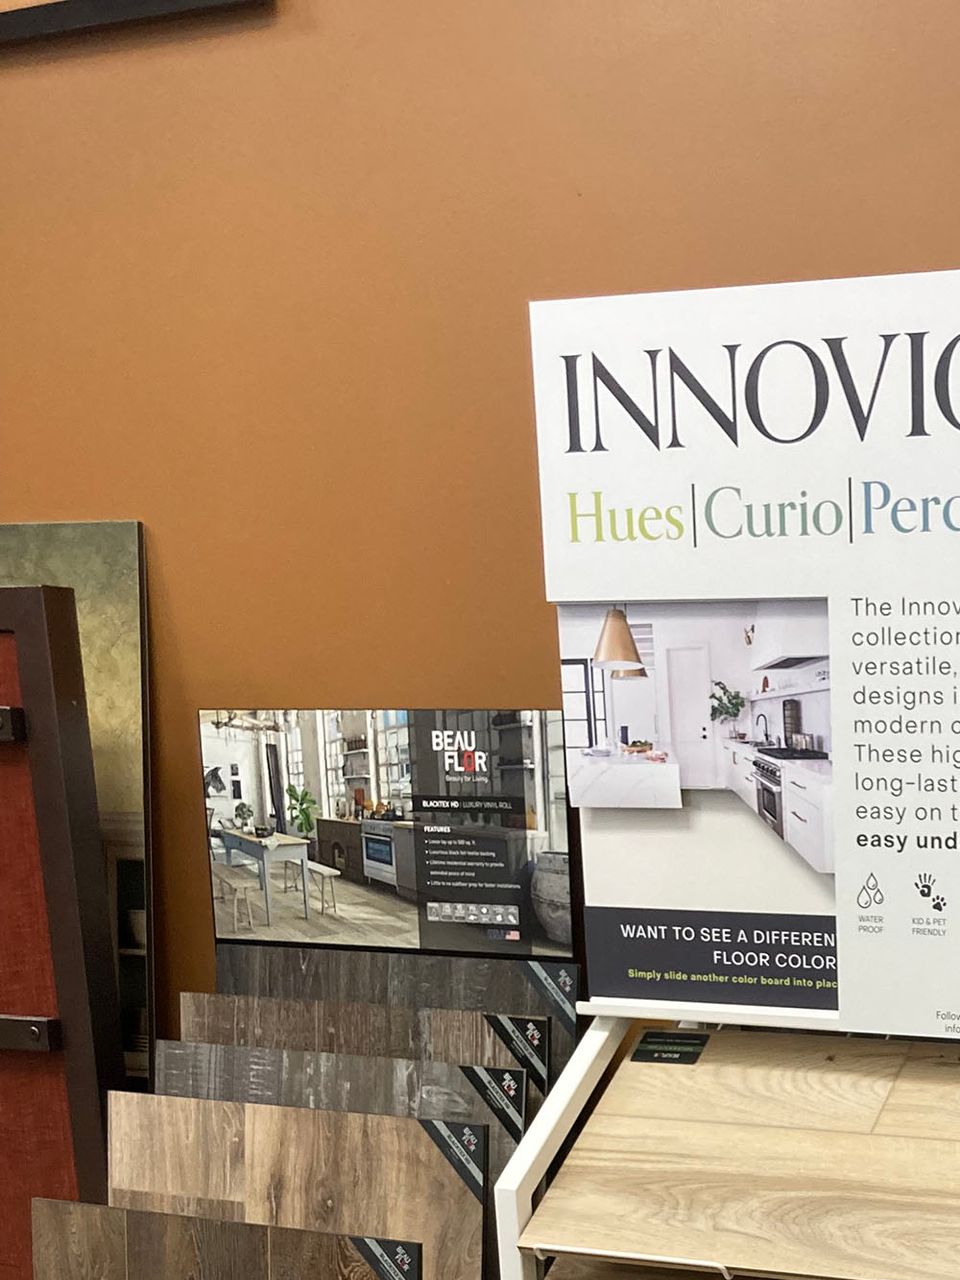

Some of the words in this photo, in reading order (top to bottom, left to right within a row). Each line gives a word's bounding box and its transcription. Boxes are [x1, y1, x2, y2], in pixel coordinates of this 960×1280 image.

[850, 597, 892, 616] The
[852, 657, 958, 678] versatile,
[853, 685, 944, 710] designs
[853, 715, 942, 734] modern
[431, 730, 476, 751] BEAU
[854, 744, 922, 763] These
[855, 805, 906, 825] easy
[914, 805, 942, 821] on
[856, 832, 908, 853] easy
[858, 915, 884, 924] WATER
[912, 917, 926, 926] KID
[932, 918, 947, 926] PET
[620, 924, 668, 940] WANT
[672, 926, 696, 941] TO
[700, 927, 732, 943] SEE
[737, 929, 748, 943] A
[858, 925, 884, 934] PROOF
[911, 927, 947, 937] FRIENDLY
[713, 950, 770, 967] FLOOR
[775, 953, 837, 969] COLOR
[628, 968, 661, 982] Simply
[664, 970, 688, 982] slide
[691, 971, 728, 983] another
[732, 973, 758, 984] color
[760, 974, 790, 986] board
[793, 975, 813, 987] into
